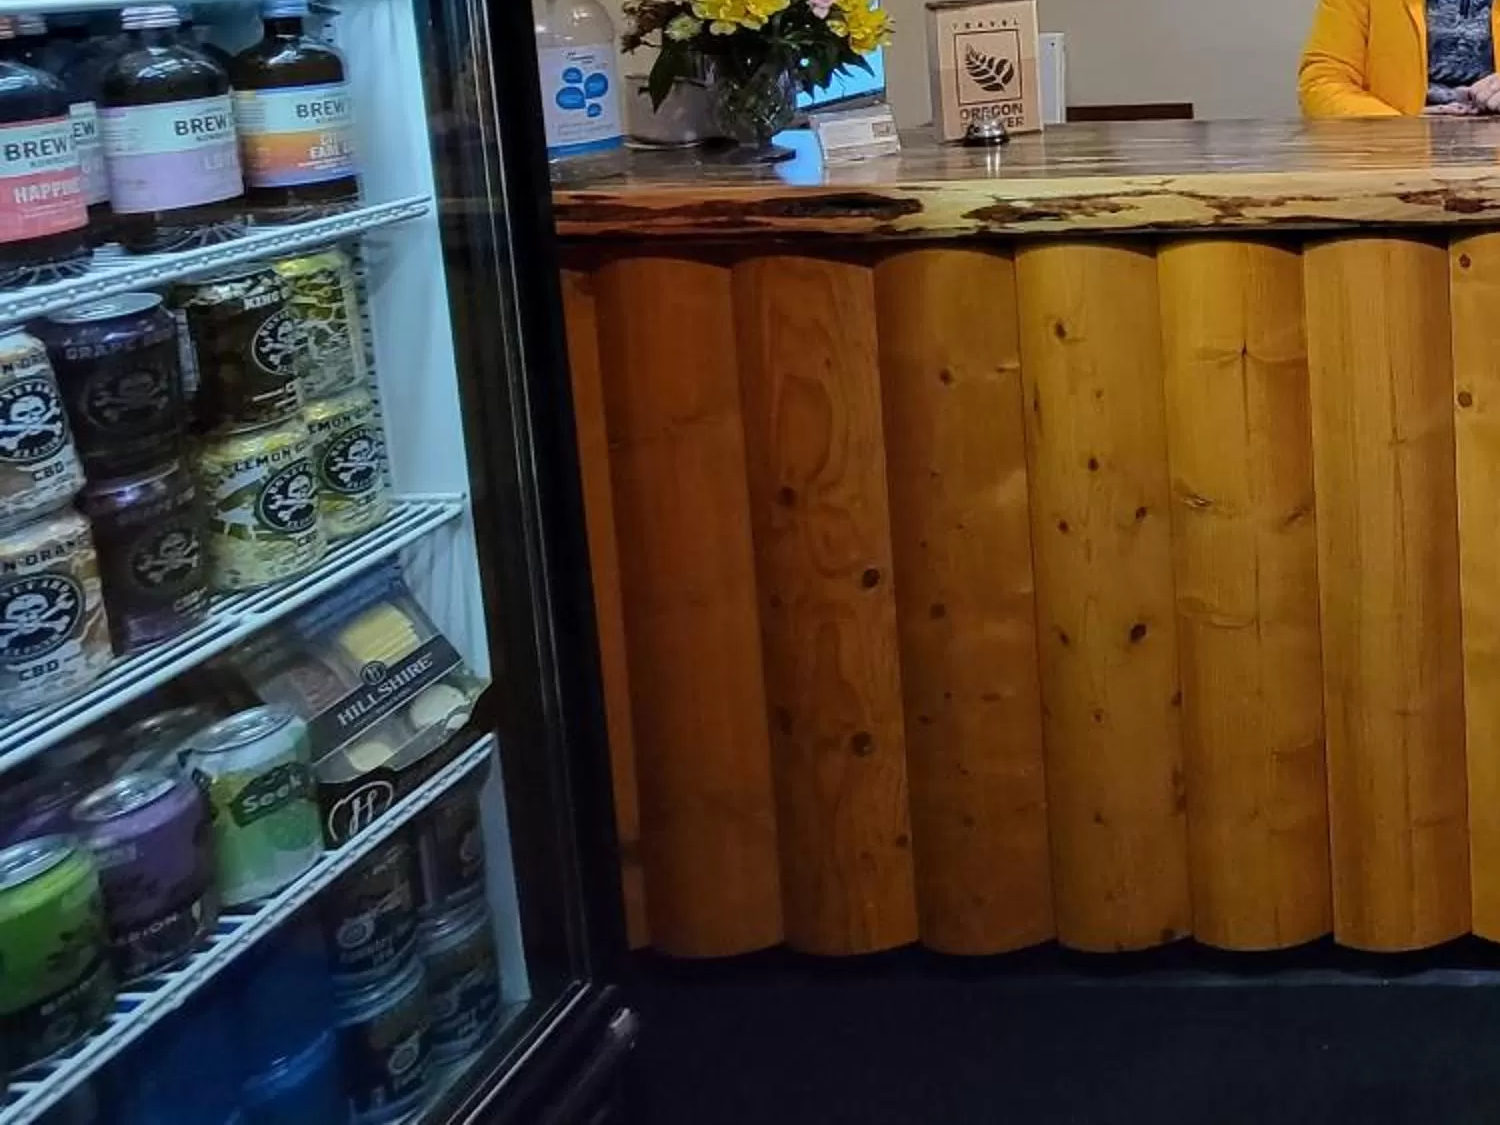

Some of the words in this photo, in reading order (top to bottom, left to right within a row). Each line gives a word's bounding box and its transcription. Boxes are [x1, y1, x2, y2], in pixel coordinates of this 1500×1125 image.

[296, 99, 345, 119] BREW
[960, 102, 1023, 122] OREGON
[174, 113, 227, 137] BREW
[4, 136, 68, 162] BREW
[308, 415, 351, 435] EMON
[32, 460, 65, 482] CBD
[19, 659, 59, 681] CBD
[336, 652, 434, 726] HILLSHIRE
